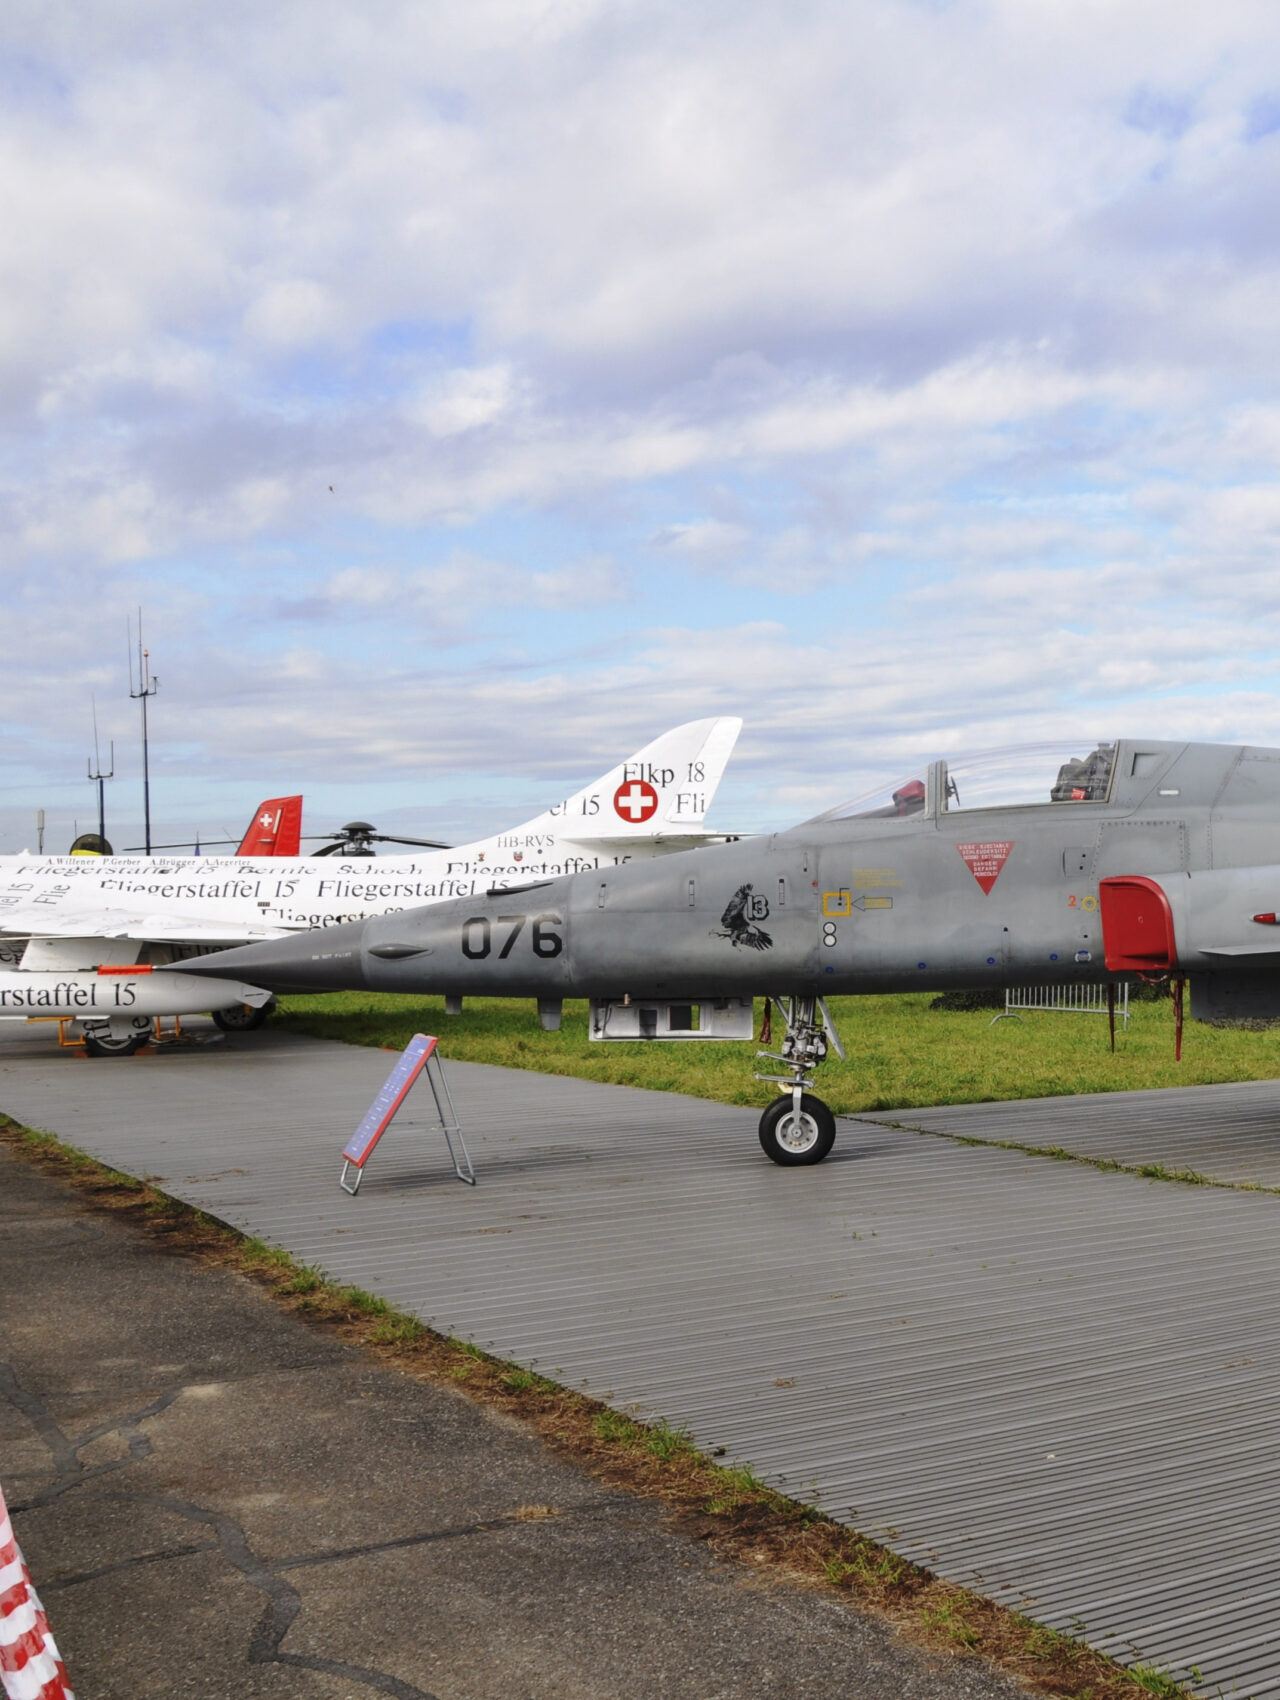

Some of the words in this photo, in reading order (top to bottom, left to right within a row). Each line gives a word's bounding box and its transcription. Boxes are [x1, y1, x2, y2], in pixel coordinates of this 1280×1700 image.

[687, 761, 705, 783] 18
[581, 794, 600, 816] 15
[676, 792, 705, 814] Fli
[497, 834, 555, 849] HB-RVS
[317, 878, 475, 901] Fliegerstaffel
[747, 895, 769, 921] 13
[1067, 894, 1077, 908] 2
[461, 914, 562, 959] 076
[113, 982, 137, 1007] 15
